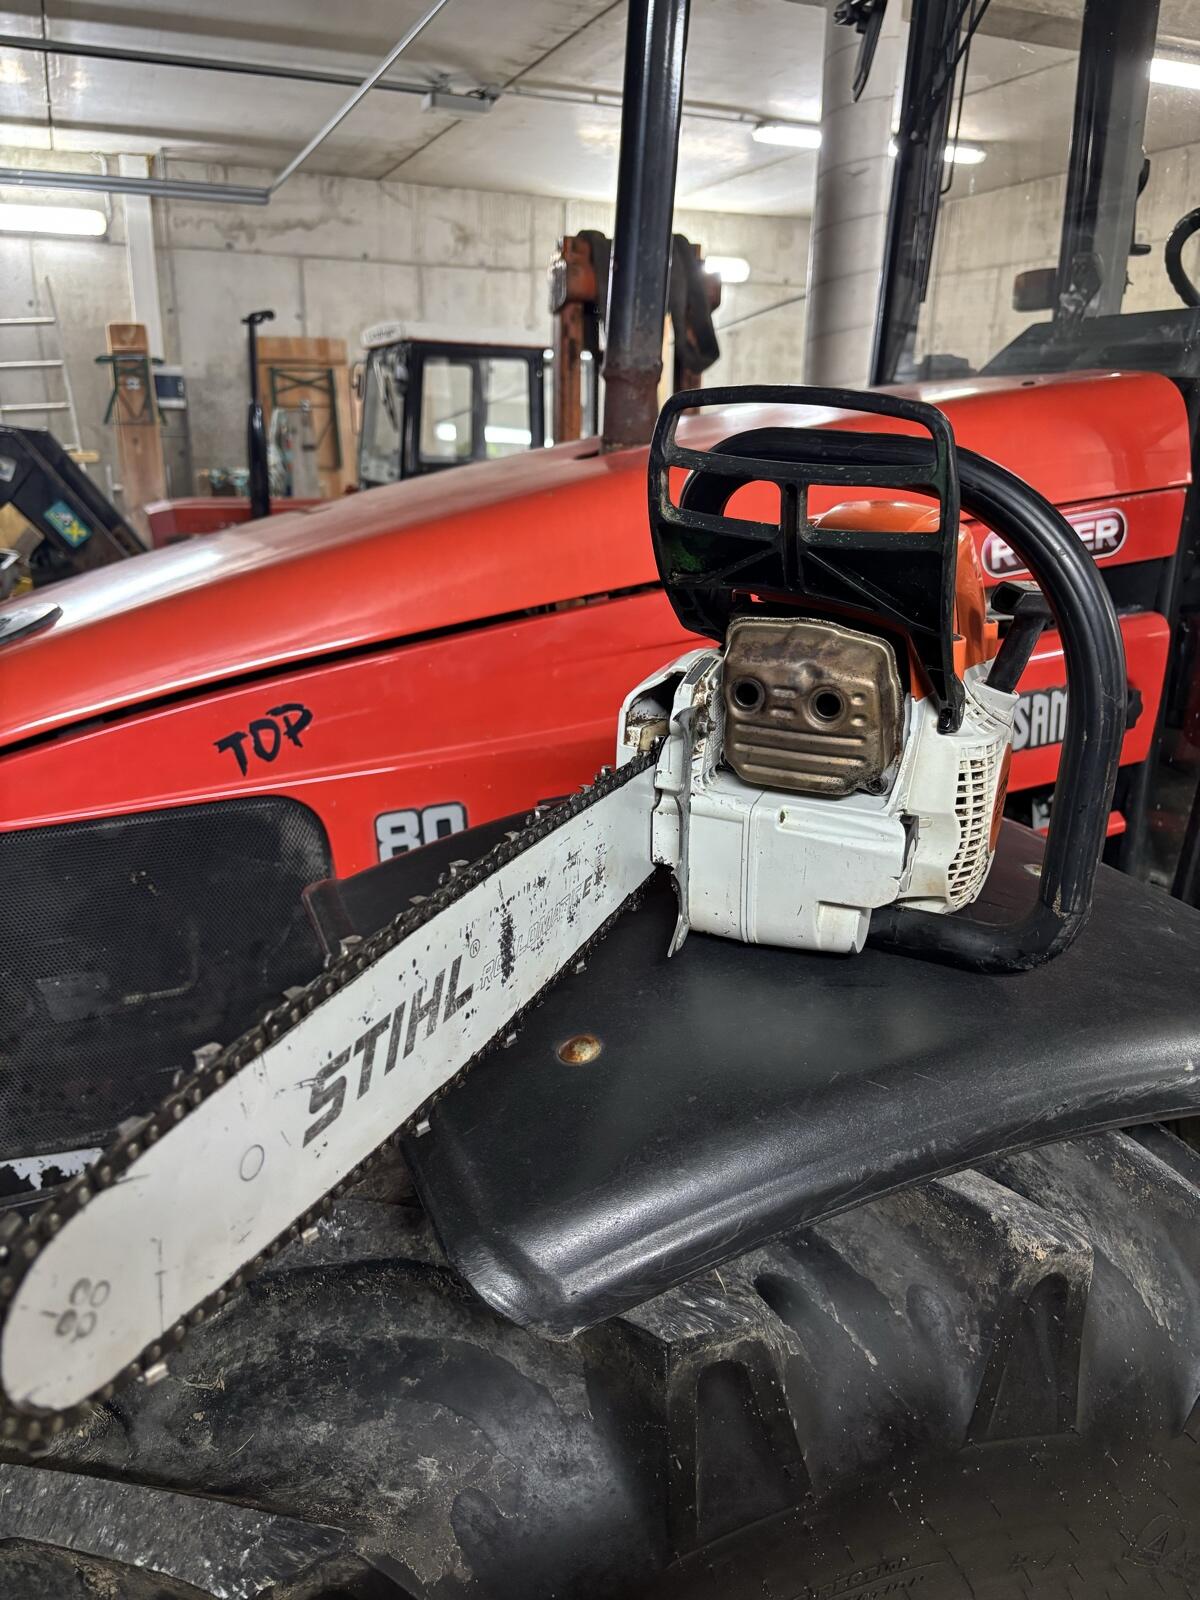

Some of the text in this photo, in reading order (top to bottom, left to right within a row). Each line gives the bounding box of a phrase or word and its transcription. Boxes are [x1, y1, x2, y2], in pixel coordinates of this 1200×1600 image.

[213, 703, 313, 776] TOP
[376, 803, 466, 863] 80
[303, 954, 474, 1148] STIHL
